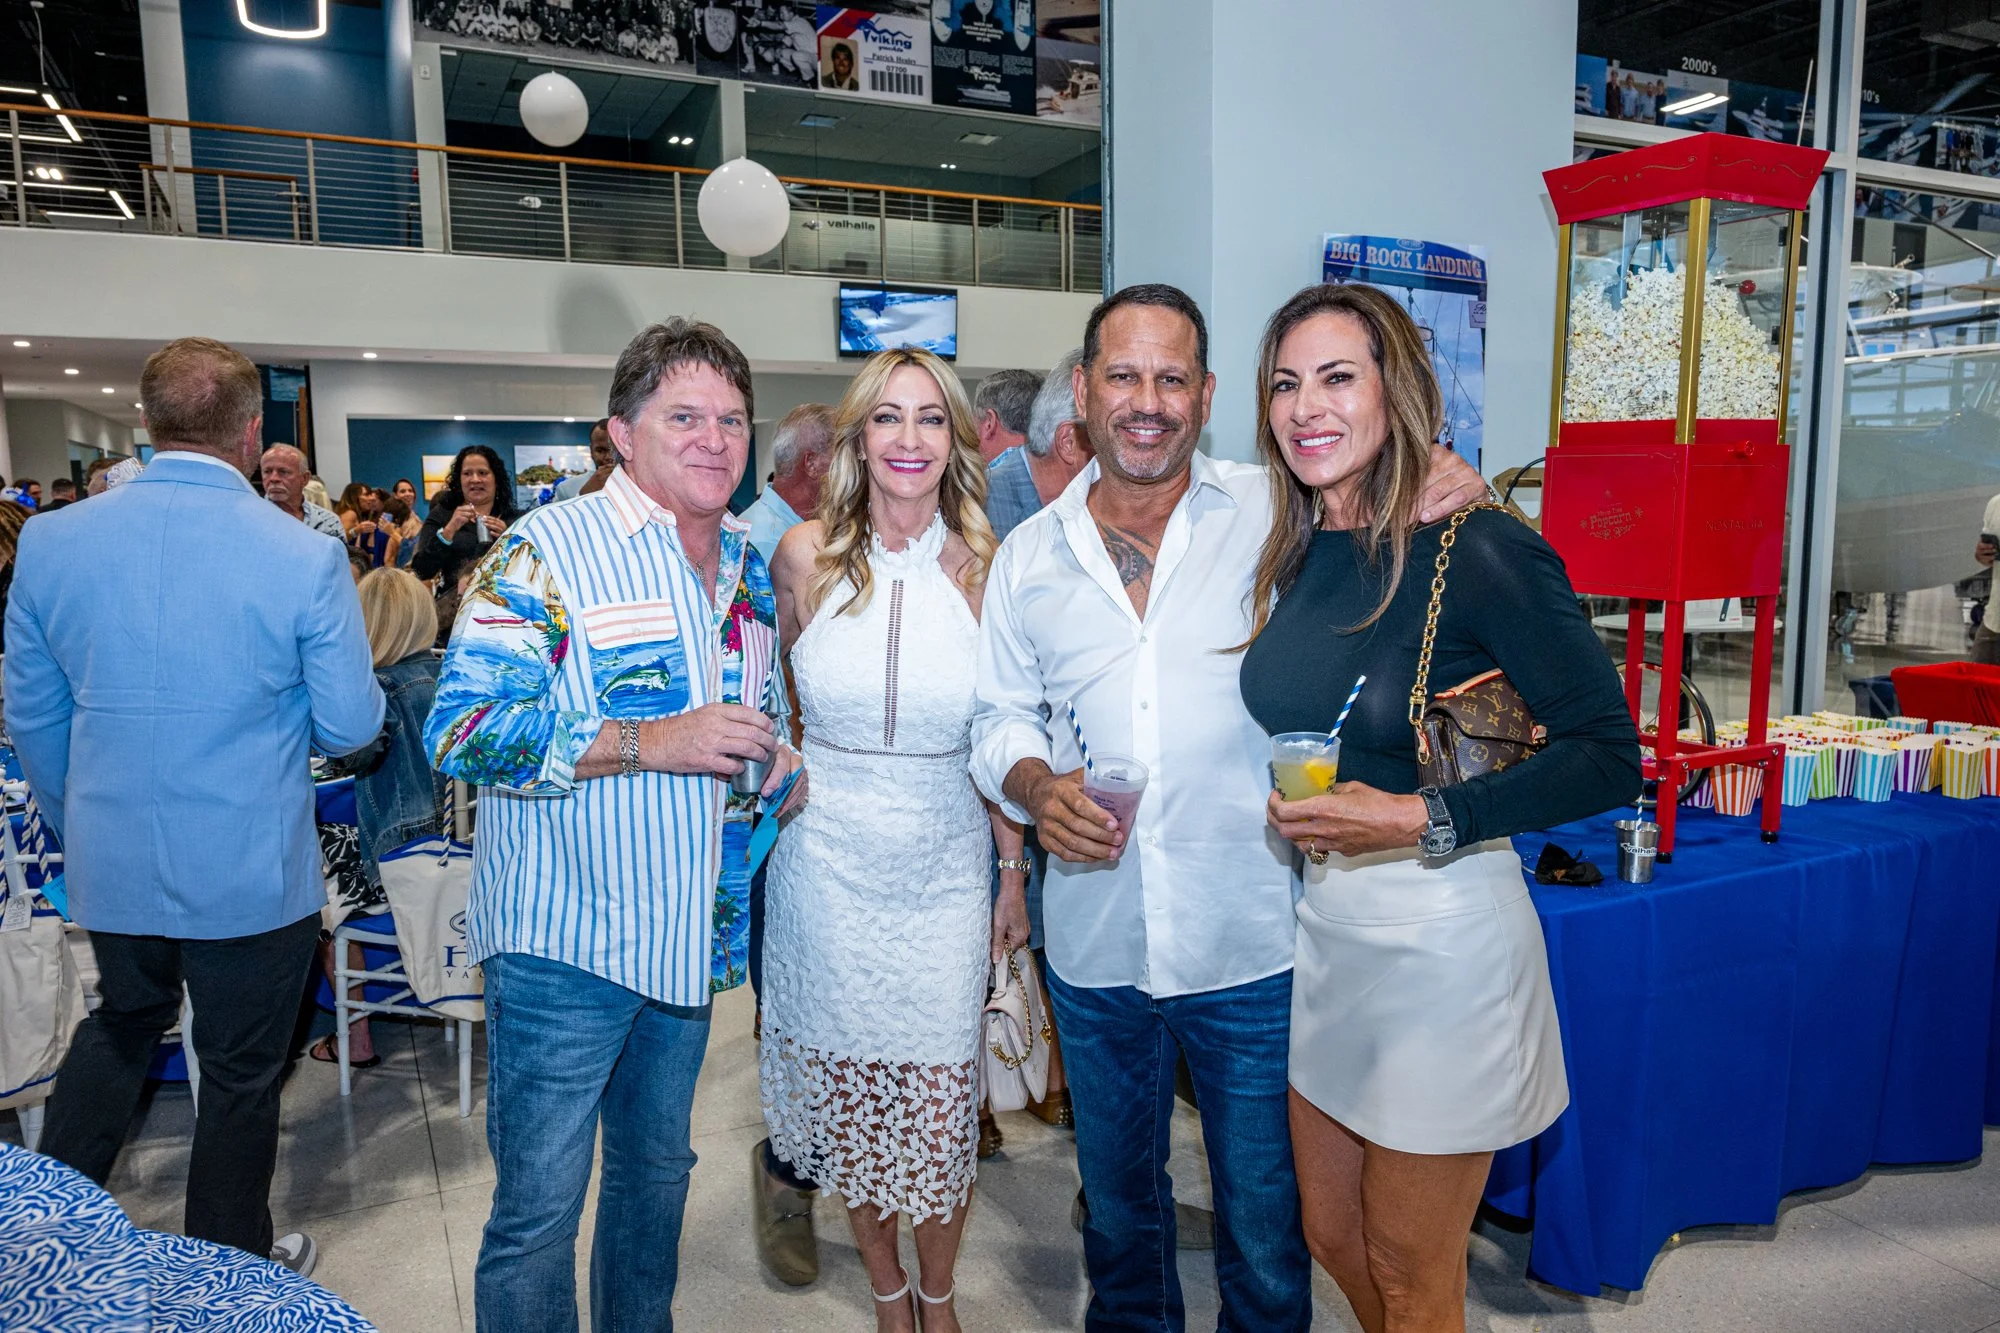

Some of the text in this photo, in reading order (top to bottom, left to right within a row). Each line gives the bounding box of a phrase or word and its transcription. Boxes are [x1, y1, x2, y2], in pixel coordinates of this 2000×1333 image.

[871, 34, 912, 50] viking
[1682, 56, 1717, 75] 2000's
[1862, 89, 1880, 104] 10's
[827, 220, 876, 231] valhalla
[1330, 240, 1483, 279] BIG ROCK LANDING
[1589, 511, 1632, 529] Popcorn
